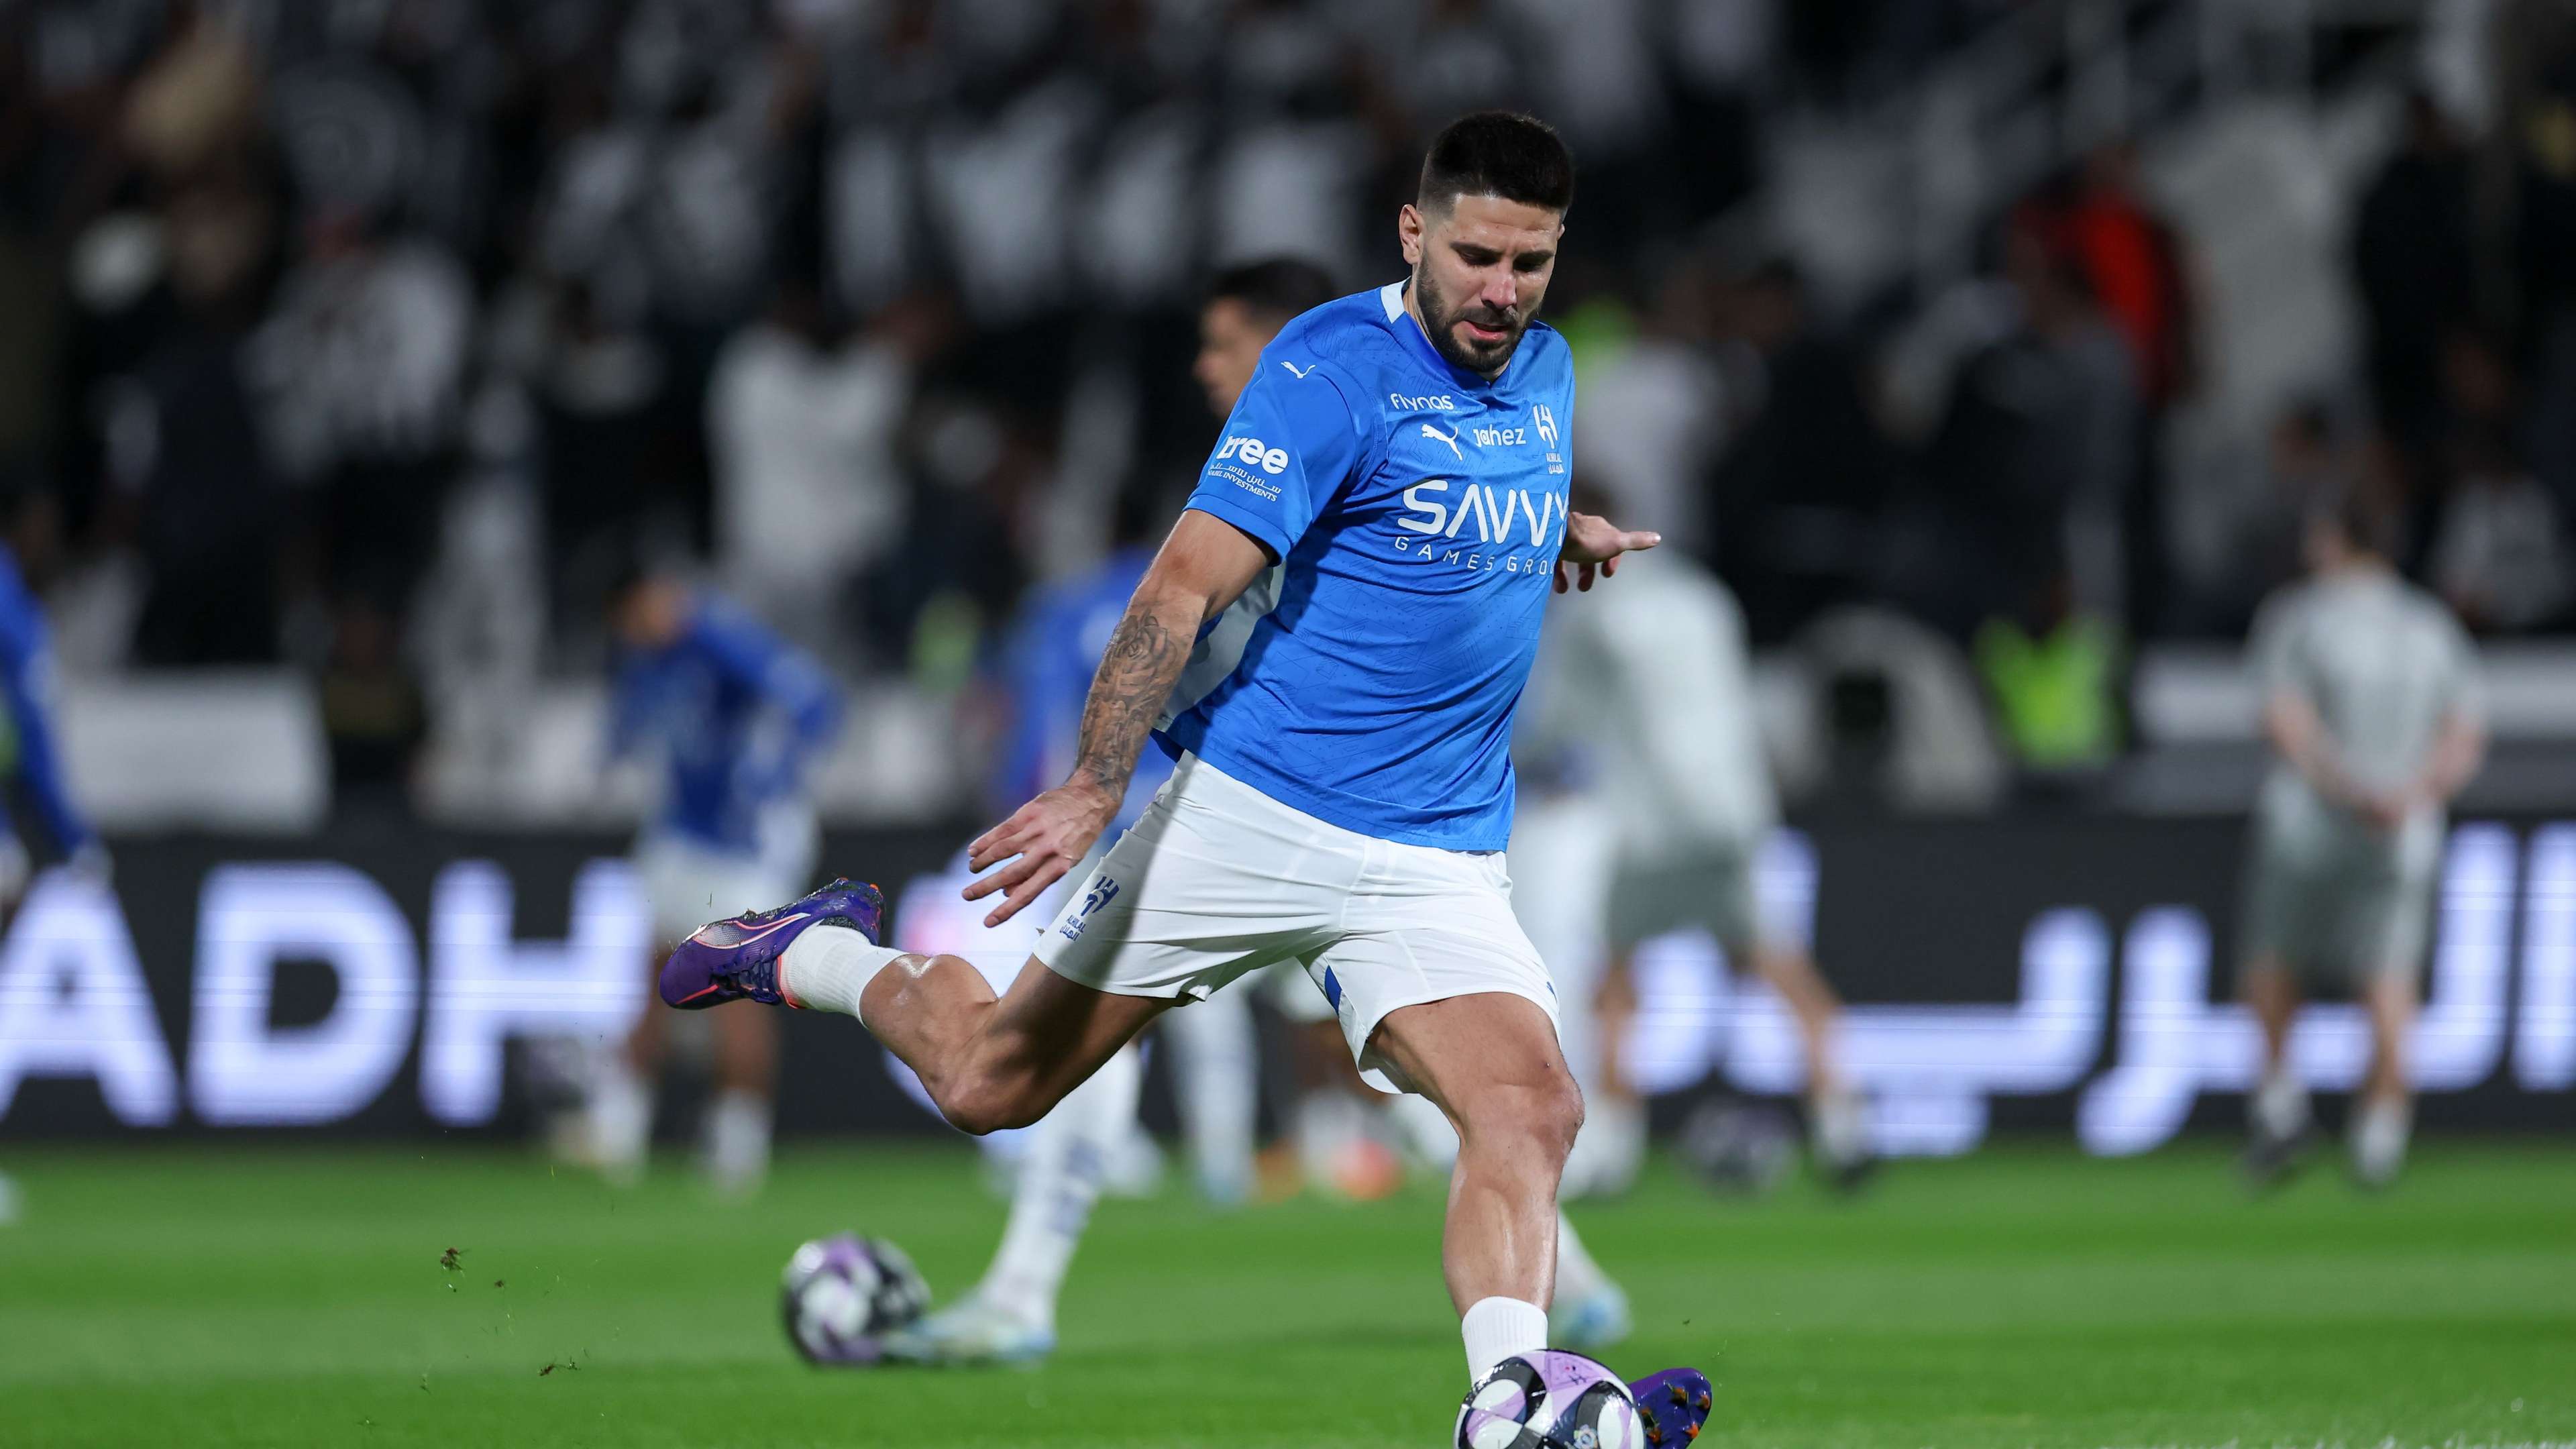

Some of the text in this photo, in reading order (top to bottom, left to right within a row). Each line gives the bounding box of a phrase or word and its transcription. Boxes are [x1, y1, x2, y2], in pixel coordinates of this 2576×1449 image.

[1391, 393, 1454, 411] flynas
[1223, 471, 1277, 502] INVESTMENTS
[1395, 536, 1495, 570] GAMES
